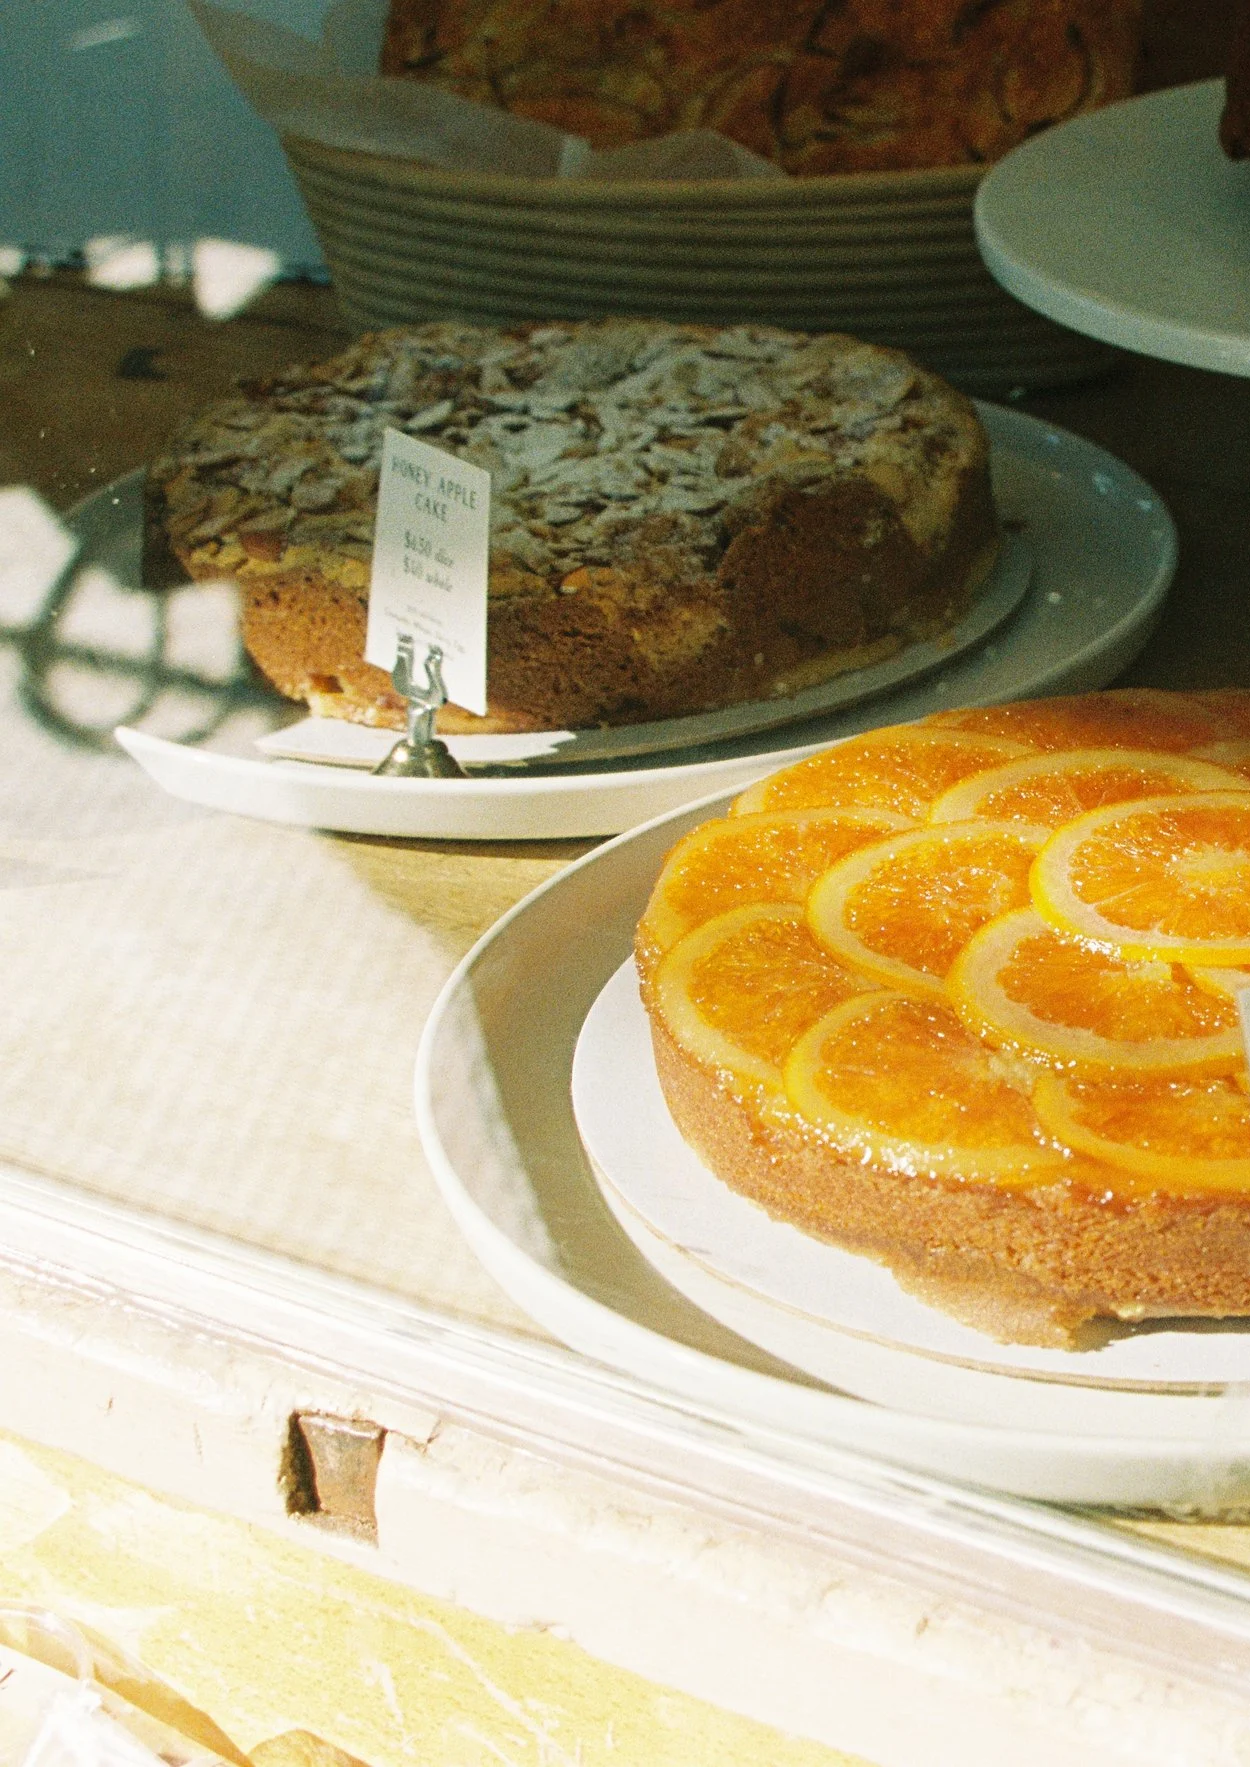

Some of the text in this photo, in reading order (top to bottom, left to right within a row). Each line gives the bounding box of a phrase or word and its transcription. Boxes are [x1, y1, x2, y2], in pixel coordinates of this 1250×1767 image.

[391, 456, 477, 511] HONEY APPLE
[414, 492, 449, 524] CAKE
